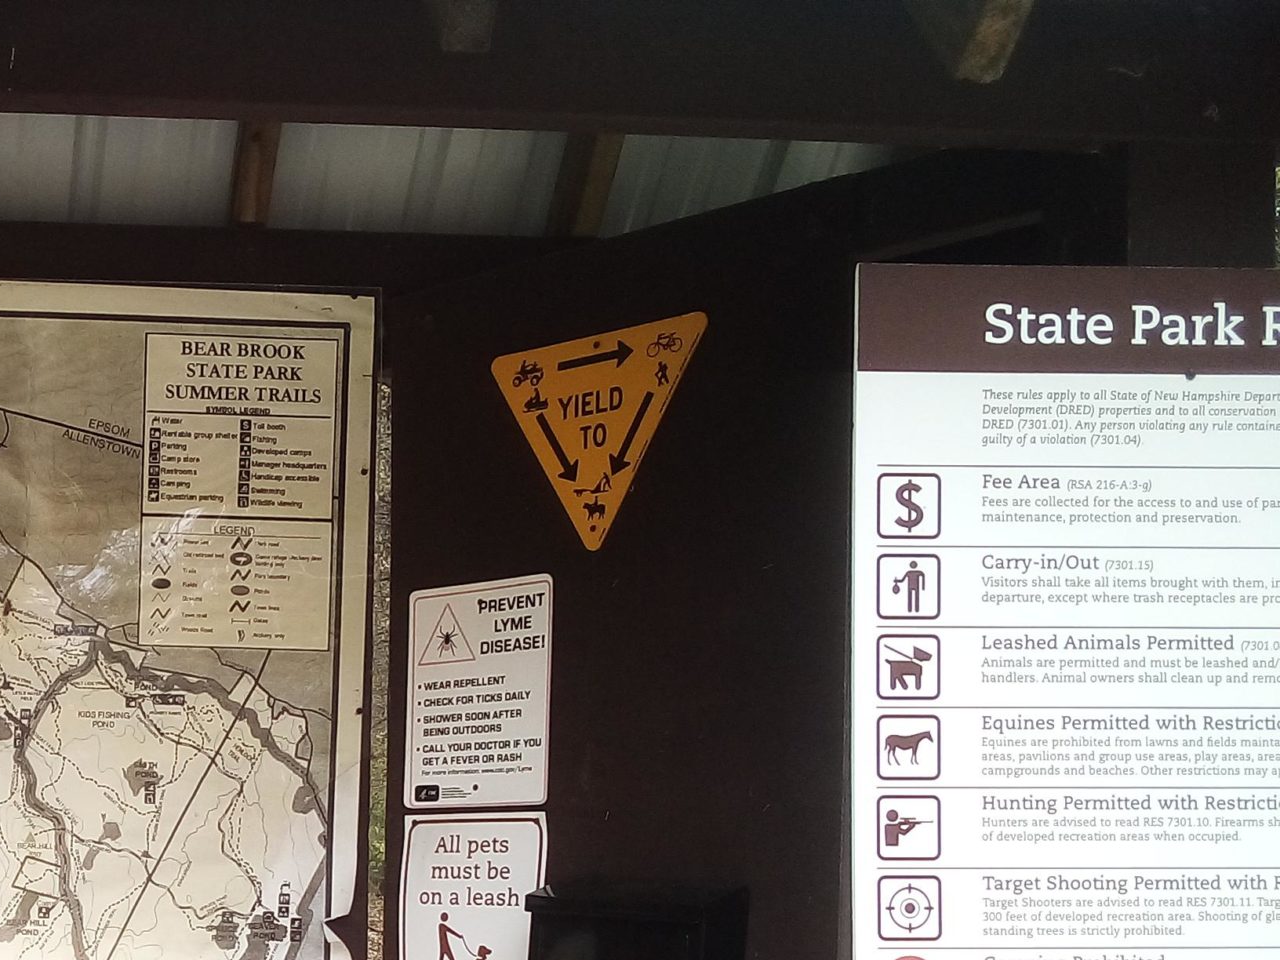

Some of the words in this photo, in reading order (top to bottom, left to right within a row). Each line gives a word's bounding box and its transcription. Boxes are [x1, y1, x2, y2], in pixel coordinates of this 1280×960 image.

[985, 303, 1113, 344] State
[1131, 302, 1245, 345] Park
[181, 341, 232, 357] BEAR
[237, 342, 306, 360] BROOK
[186, 363, 248, 379] STATE
[253, 365, 303, 381] PARK
[165, 384, 250, 402] SUMMER
[255, 387, 321, 404] TRAILS
[558, 386, 623, 420] YIELD
[206, 405, 237, 415] SYMBOL
[240, 407, 270, 416] LEGEND
[88, 418, 131, 438] EPSOM
[579, 422, 607, 450] TO
[62, 428, 140, 460] ALLENSTOWN
[982, 433, 1013, 447] guilty
[1016, 433, 1028, 447] of
[1030, 437, 1037, 445] a
[1040, 433, 1086, 445] violation
[1090, 434, 1144, 448] (7301.04).
[983, 474, 1012, 489] Fee
[1018, 475, 1060, 489] Area
[1067, 479, 1092, 491] (RSA
[1096, 480, 1151, 492] 216-A:3-g)
[214, 525, 255, 536] LEGEND
[982, 553, 1099, 574] Carry-in/Out
[1105, 560, 1153, 572] (7301.15)
[478, 593, 545, 614] PREVENT
[494, 616, 532, 633] LYME
[480, 635, 546, 654] DISEASE!
[982, 634, 1058, 650] Leashed
[1064, 634, 1140, 650] Animals
[1147, 635, 1234, 650] Permitted
[424, 680, 451, 690] WEAR
[454, 676, 506, 688] REPELLENT
[424, 697, 454, 707] CHECK
[457, 695, 473, 704] FOR
[476, 693, 502, 703] TICKS
[505, 691, 531, 701] DAILY
[77, 711, 96, 719] KIDS
[97, 711, 131, 720] FISHING
[92, 720, 115, 728] POND
[423, 713, 462, 724] SHOWER
[465, 712, 490, 721] SOON
[492, 709, 522, 719] AFTER
[982, 715, 1054, 734] Equines
[1062, 714, 1150, 730] Permitted
[1156, 714, 1197, 730] with
[423, 727, 450, 736] BEING
[452, 724, 502, 735] OUTDOORS
[423, 744, 445, 753] CALL
[448, 742, 472, 752] YOUR
[474, 740, 511, 750] DOCTOR
[513, 739, 521, 748] IF
[523, 738, 542, 748] YOU
[422, 756, 440, 766] GET
[442, 756, 449, 765] A
[451, 754, 480, 764] FEVER
[482, 754, 495, 763] OR
[497, 753, 522, 762] RASH
[982, 795, 1057, 815] Hunting
[1064, 794, 1151, 810] Permitted
[1158, 795, 1198, 810] with
[434, 835, 461, 854] All
[467, 837, 509, 858] pets
[431, 863, 481, 880] must
[487, 861, 511, 880] be
[982, 876, 1041, 895] Target
[1047, 875, 1128, 895] Shooting
[1134, 874, 1221, 890] Permitted
[1227, 874, 1267, 890] with
[419, 890, 443, 905] on
[449, 890, 460, 905] a
[466, 887, 520, 907] leash
